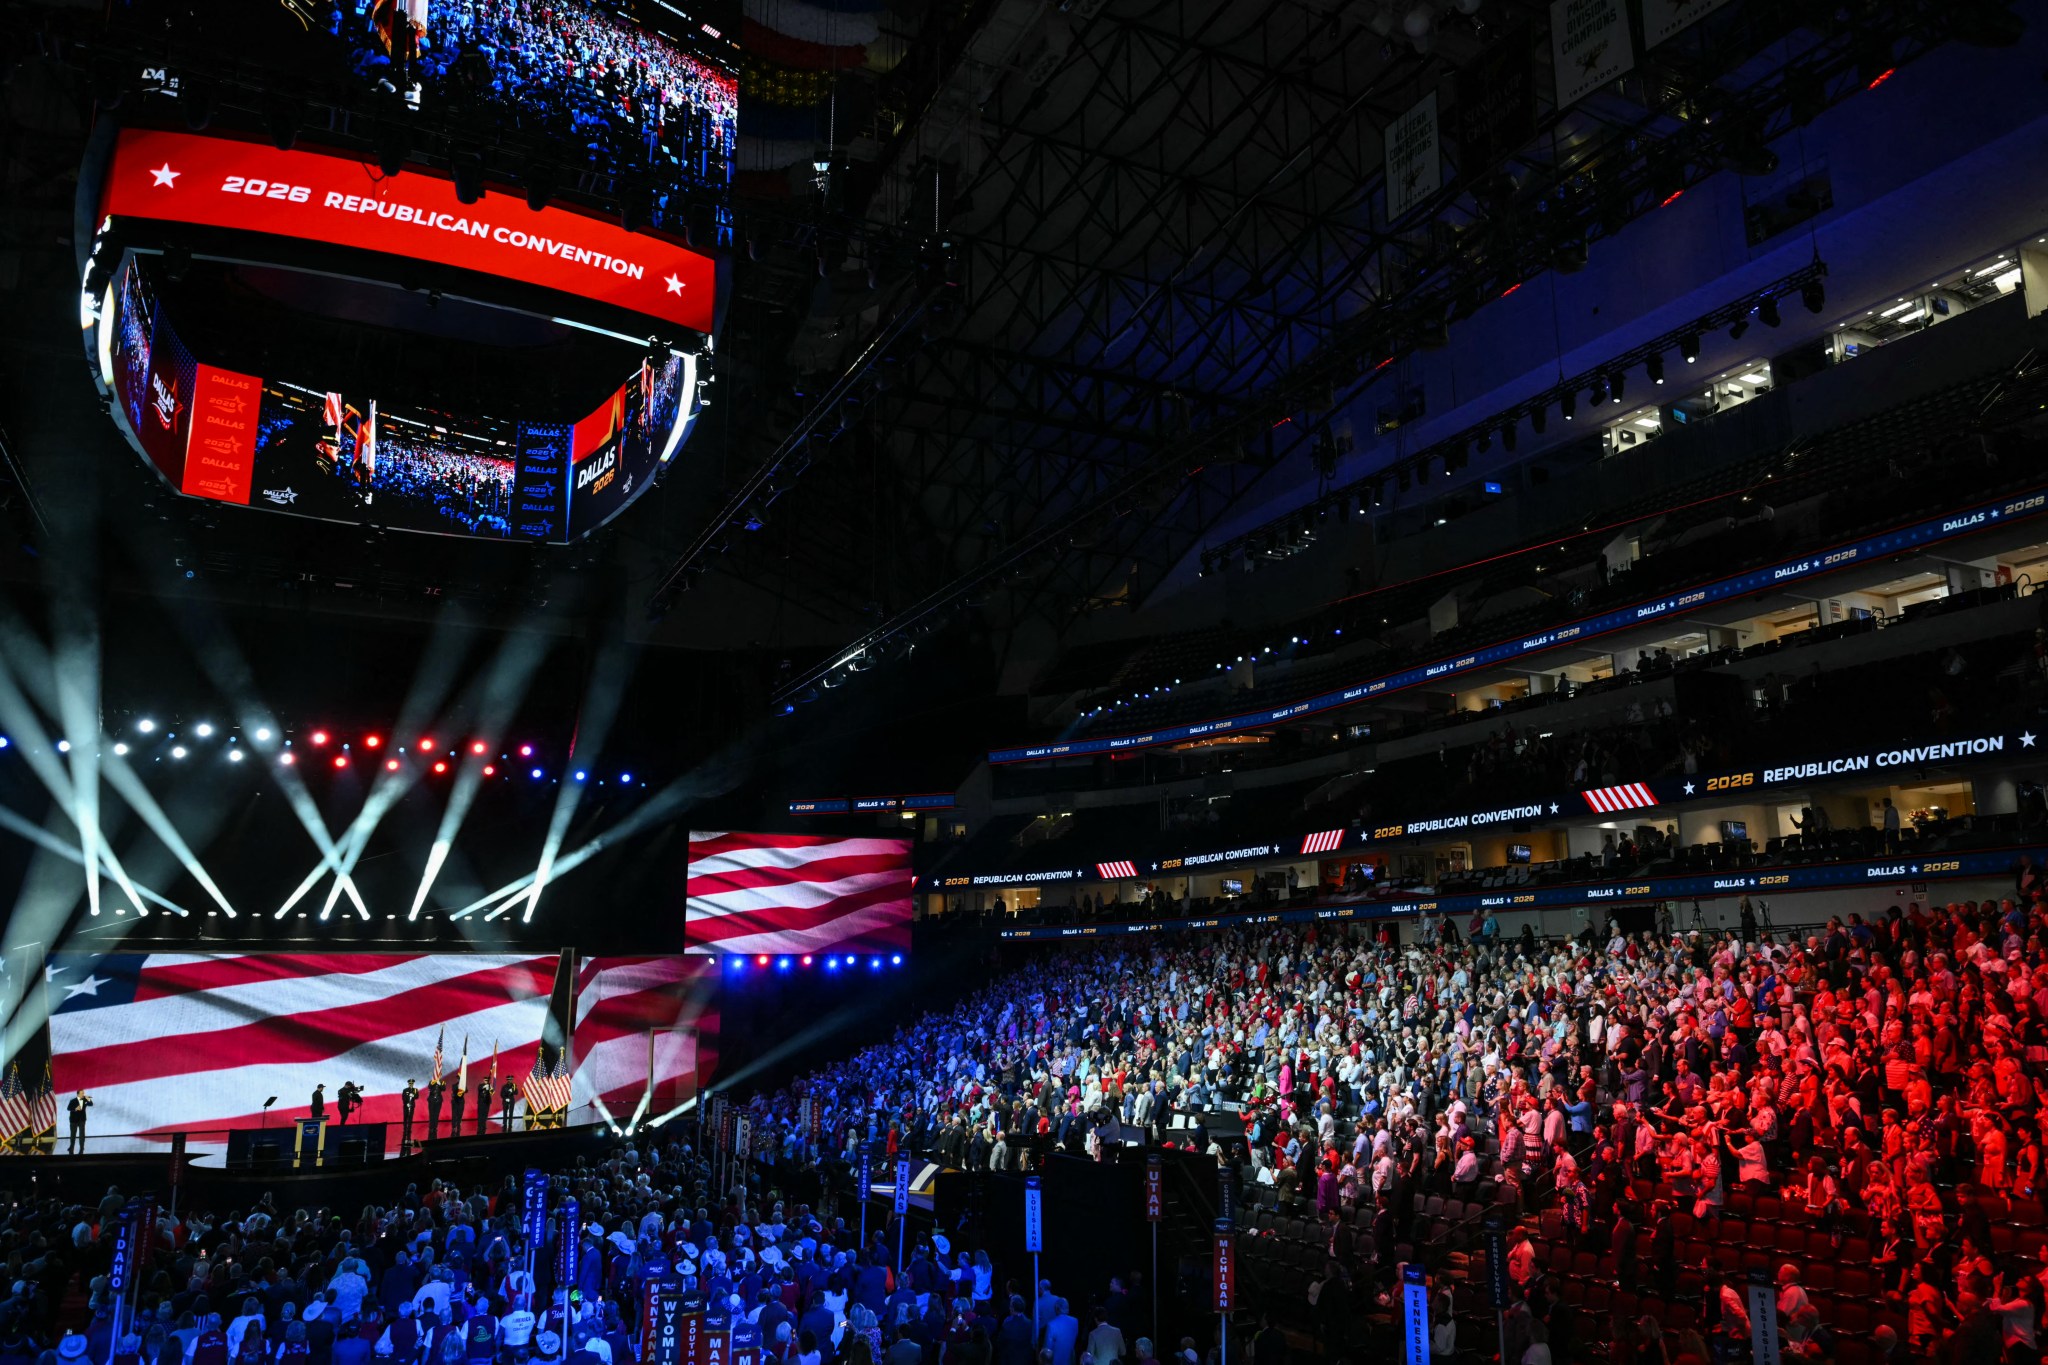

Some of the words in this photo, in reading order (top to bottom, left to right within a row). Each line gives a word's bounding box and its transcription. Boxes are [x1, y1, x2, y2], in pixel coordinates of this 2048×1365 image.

[1561, 9, 1617, 55] CHAMPIONS
[1395, 111, 1426, 142] WESTERN
[1389, 120, 1433, 161] CONFERENCE
[221, 175, 312, 204] 2026
[324, 191, 490, 239] REPUBLICAN
[493, 227, 644, 280] CONVENTION
[153, 373, 175, 412] DALLAS
[211, 375, 250, 390] DALLAS
[209, 397, 236, 408] 2026
[206, 415, 245, 430] DALLAS
[527, 428, 560, 437] DALLAS
[204, 438, 231, 449] 2026
[201, 457, 241, 471] DALLAS
[524, 465, 557, 475] DALLAS
[577, 445, 616, 490] DALLAS
[199, 479, 227, 490] 2026
[592, 467, 615, 495] 2026
[263, 489, 290, 499] DALLAS
[521, 504, 555, 512] DALLAS
[1943, 512, 1985, 532] DALLAS
[2004, 495, 2045, 515] 2026
[1775, 562, 1809, 579] DALLAS
[1824, 549, 1857, 565] 2026
[1637, 602, 1666, 617] DALLAS
[1678, 591, 1705, 606] 2026
[1523, 636, 1547, 649] DALLAS
[1557, 627, 1580, 639] 2026
[1426, 664, 1447, 676] DALLAS
[1455, 656, 1475, 668] 2026
[1344, 688, 1362, 699] DALLAS
[1368, 681, 1386, 692] 2026
[1272, 709, 1288, 719] DALLAS
[1294, 703, 1309, 713] 2026
[1189, 725, 1208, 734] DALLAS
[1215, 721, 1232, 729] 2026
[1110, 739, 1130, 747] DALLAS
[1137, 735, 1153, 743] 2026
[1705, 772, 1755, 791] 2026
[1763, 755, 1869, 783] REPUBLICAN
[1876, 736, 2004, 768] CONVENTION
[1374, 825, 1403, 839] 2026
[1407, 815, 1468, 834] REPUBLICAN
[1471, 804, 1542, 825] CONVENTION
[1162, 859, 1182, 869] 2026
[1184, 852, 1223, 866] REPUBLICAN
[1225, 845, 1269, 860] CONVENTION
[945, 877, 970, 886] 2026
[973, 874, 1023, 884] REPUBLICAN
[1025, 870, 1073, 882] CONVENTION
[1867, 865, 1906, 877] DALLAS
[1923, 861, 1960, 872] 2026
[1588, 888, 1614, 898] DALLAS
[1625, 886, 1650, 895] 2026
[1714, 878, 1745, 889] DALLAS
[1759, 875, 1789, 885] 2026
[1482, 897, 1504, 906] DALLAS
[1513, 895, 1535, 903] 2026
[1338, 909, 1354, 917] 2026
[898, 1164, 906, 1210] TEXAS
[1149, 1171, 1159, 1216] UTAH
[112, 1226, 126, 1288] IDAHO
[1219, 1240, 1228, 1307] MICHIGAN
[1492, 1236, 1501, 1305] PENNSYLVANIA
[647, 1283, 660, 1363] MONTANA
[688, 1320, 696, 1357] SOUTH
